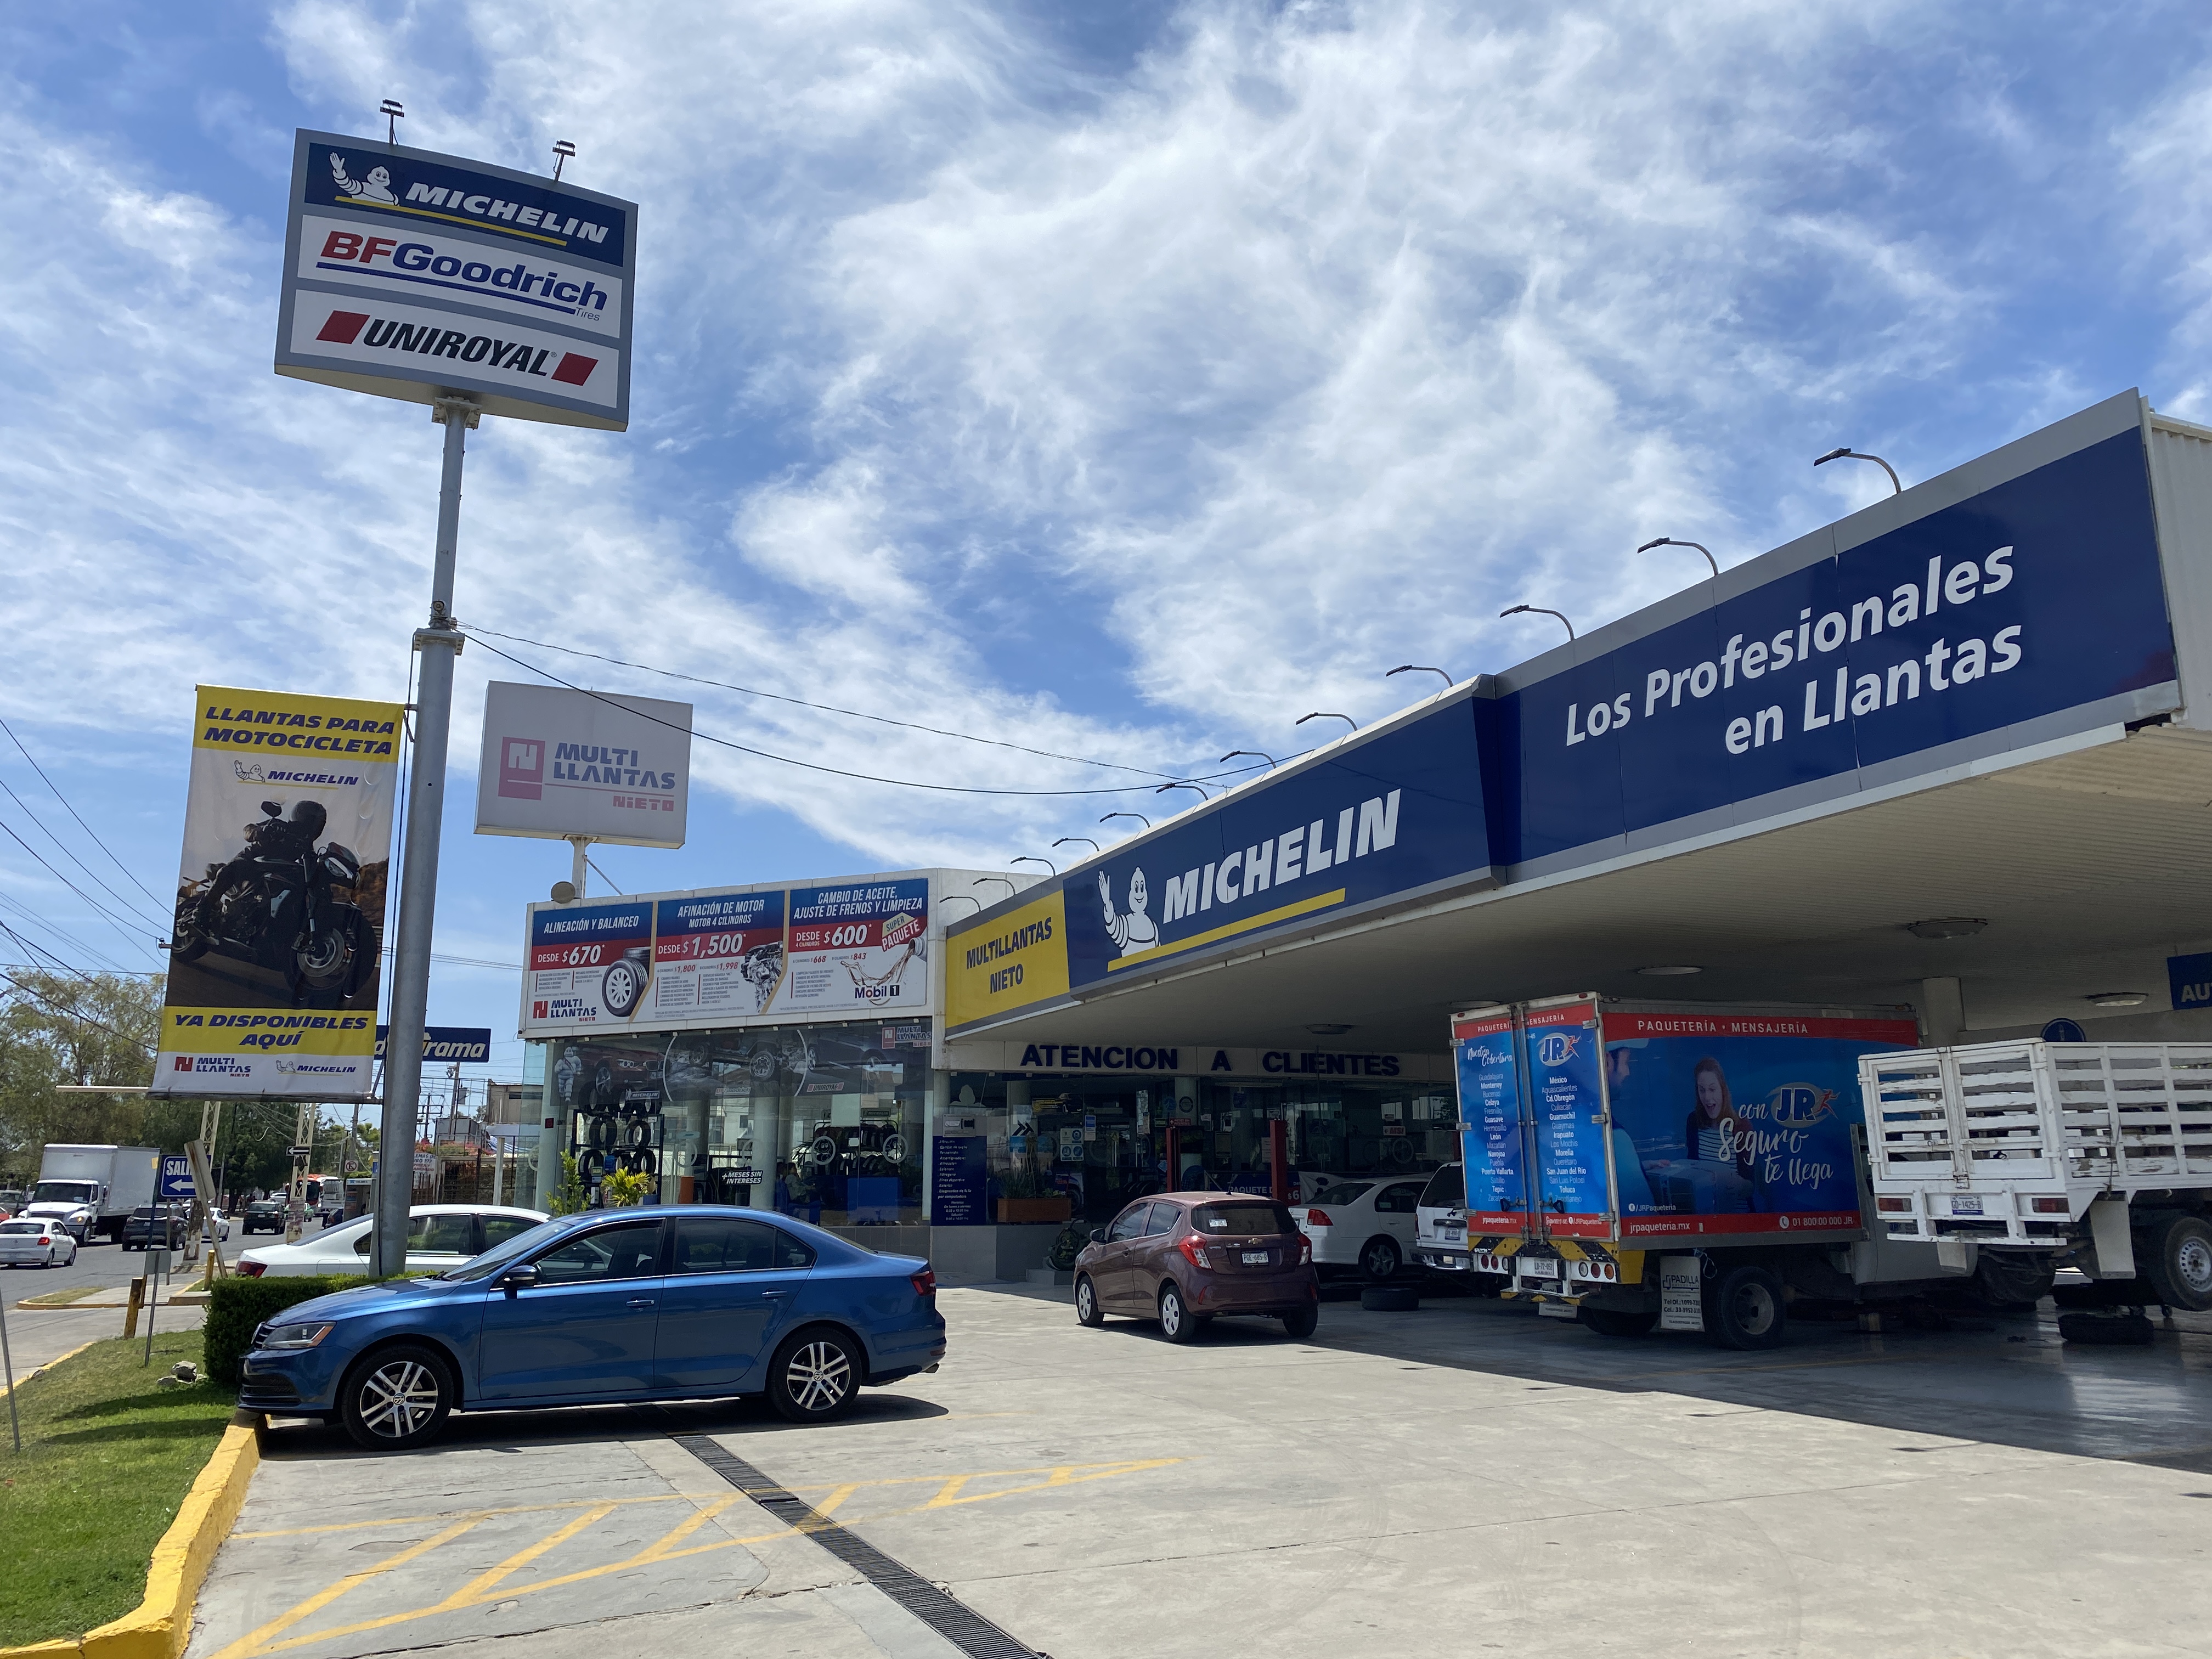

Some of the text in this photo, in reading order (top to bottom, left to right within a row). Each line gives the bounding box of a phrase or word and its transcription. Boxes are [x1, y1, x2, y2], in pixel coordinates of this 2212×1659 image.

[406, 182, 608, 244] MICHELIN
[320, 230, 608, 311] BFGoodrich
[575, 307, 600, 321] Tires
[1565, 545, 2014, 747] Los Profesionales
[1725, 624, 2023, 755] en Llantas
[206, 706, 395, 735] LLANTAS PARA
[203, 727, 393, 756] MOTOCICLETA
[555, 742, 639, 767] MULTI
[267, 770, 359, 786] MICHELIN
[553, 761, 676, 789] LLANTAS
[1163, 788, 1402, 924] MICHELIN
[817, 887, 898, 904] CAMBIO DE ACEITE,
[677, 899, 765, 918] AFINACIÓN DE MOTOR
[793, 898, 923, 919] AJUSTE DE FRENOS Y LIMPIEZA
[544, 916, 639, 934] ALINEACIÓN Y BALANCEO
[689, 914, 752, 928] MOTOR 4 CILINDROS
[885, 916, 905, 932] SUPER
[796, 931, 820, 943] DESDE
[882, 919, 921, 952] PAQUETE
[966, 916, 1052, 970] MULTILLANTAS
[658, 944, 681, 955] DESDE
[538, 953, 559, 963] DESDE
[990, 965, 1024, 994] NIETO
[855, 986, 887, 999] Mobil
[2181, 983, 2212, 1003] AU
[551, 998, 583, 1008] MULTI
[550, 1007, 596, 1018] LLANTAS
[175, 1014, 369, 1030] YA DISPONIBLES
[1477, 1022, 1510, 1032] PAQUETERÍ
[1638, 1019, 1808, 1034] PAQUETERÍA MENSAJERÍA
[239, 1031, 304, 1050] AQUÍ
[896, 1031, 932, 1040] LLANTAS
[1468, 1045, 1489, 1061] Nuestra
[1542, 1036, 1566, 1063] JR
[198, 1057, 235, 1065] MULTI
[1020, 1044, 1400, 1076] ATENCION A CLIENTES
[1482, 1052, 1513, 1067] Cobertura
[296, 1065, 357, 1073] MICHELIN
[1479, 1073, 1504, 1081] Guadalajara
[1549, 1075, 1567, 1085] México
[1542, 1085, 1578, 1095] Aguascalientes
[1485, 1099, 1500, 1107] Celaya
[1738, 1087, 1816, 1122] con JR
[1551, 1122, 1575, 1131] Guaymas
[1553, 1131, 1575, 1140] Irapuato
[1718, 1117, 1809, 1166] Seguro
[1488, 1150, 1505, 1159] Navojoa
[1555, 1148, 1574, 1156] Morelia
[166, 1160, 192, 1176] SALI
[1764, 1153, 1833, 1190] te llega
[1492, 1186, 1505, 1194] Tepic
[1629, 1222, 1690, 1234] jrpaqueteria.mx
[1792, 1217, 1801, 1226] 01
[1829, 1216, 1842, 1225] 000
[1843, 1216, 1853, 1224] JR
[1672, 1274, 1699, 1284] PADILLA
